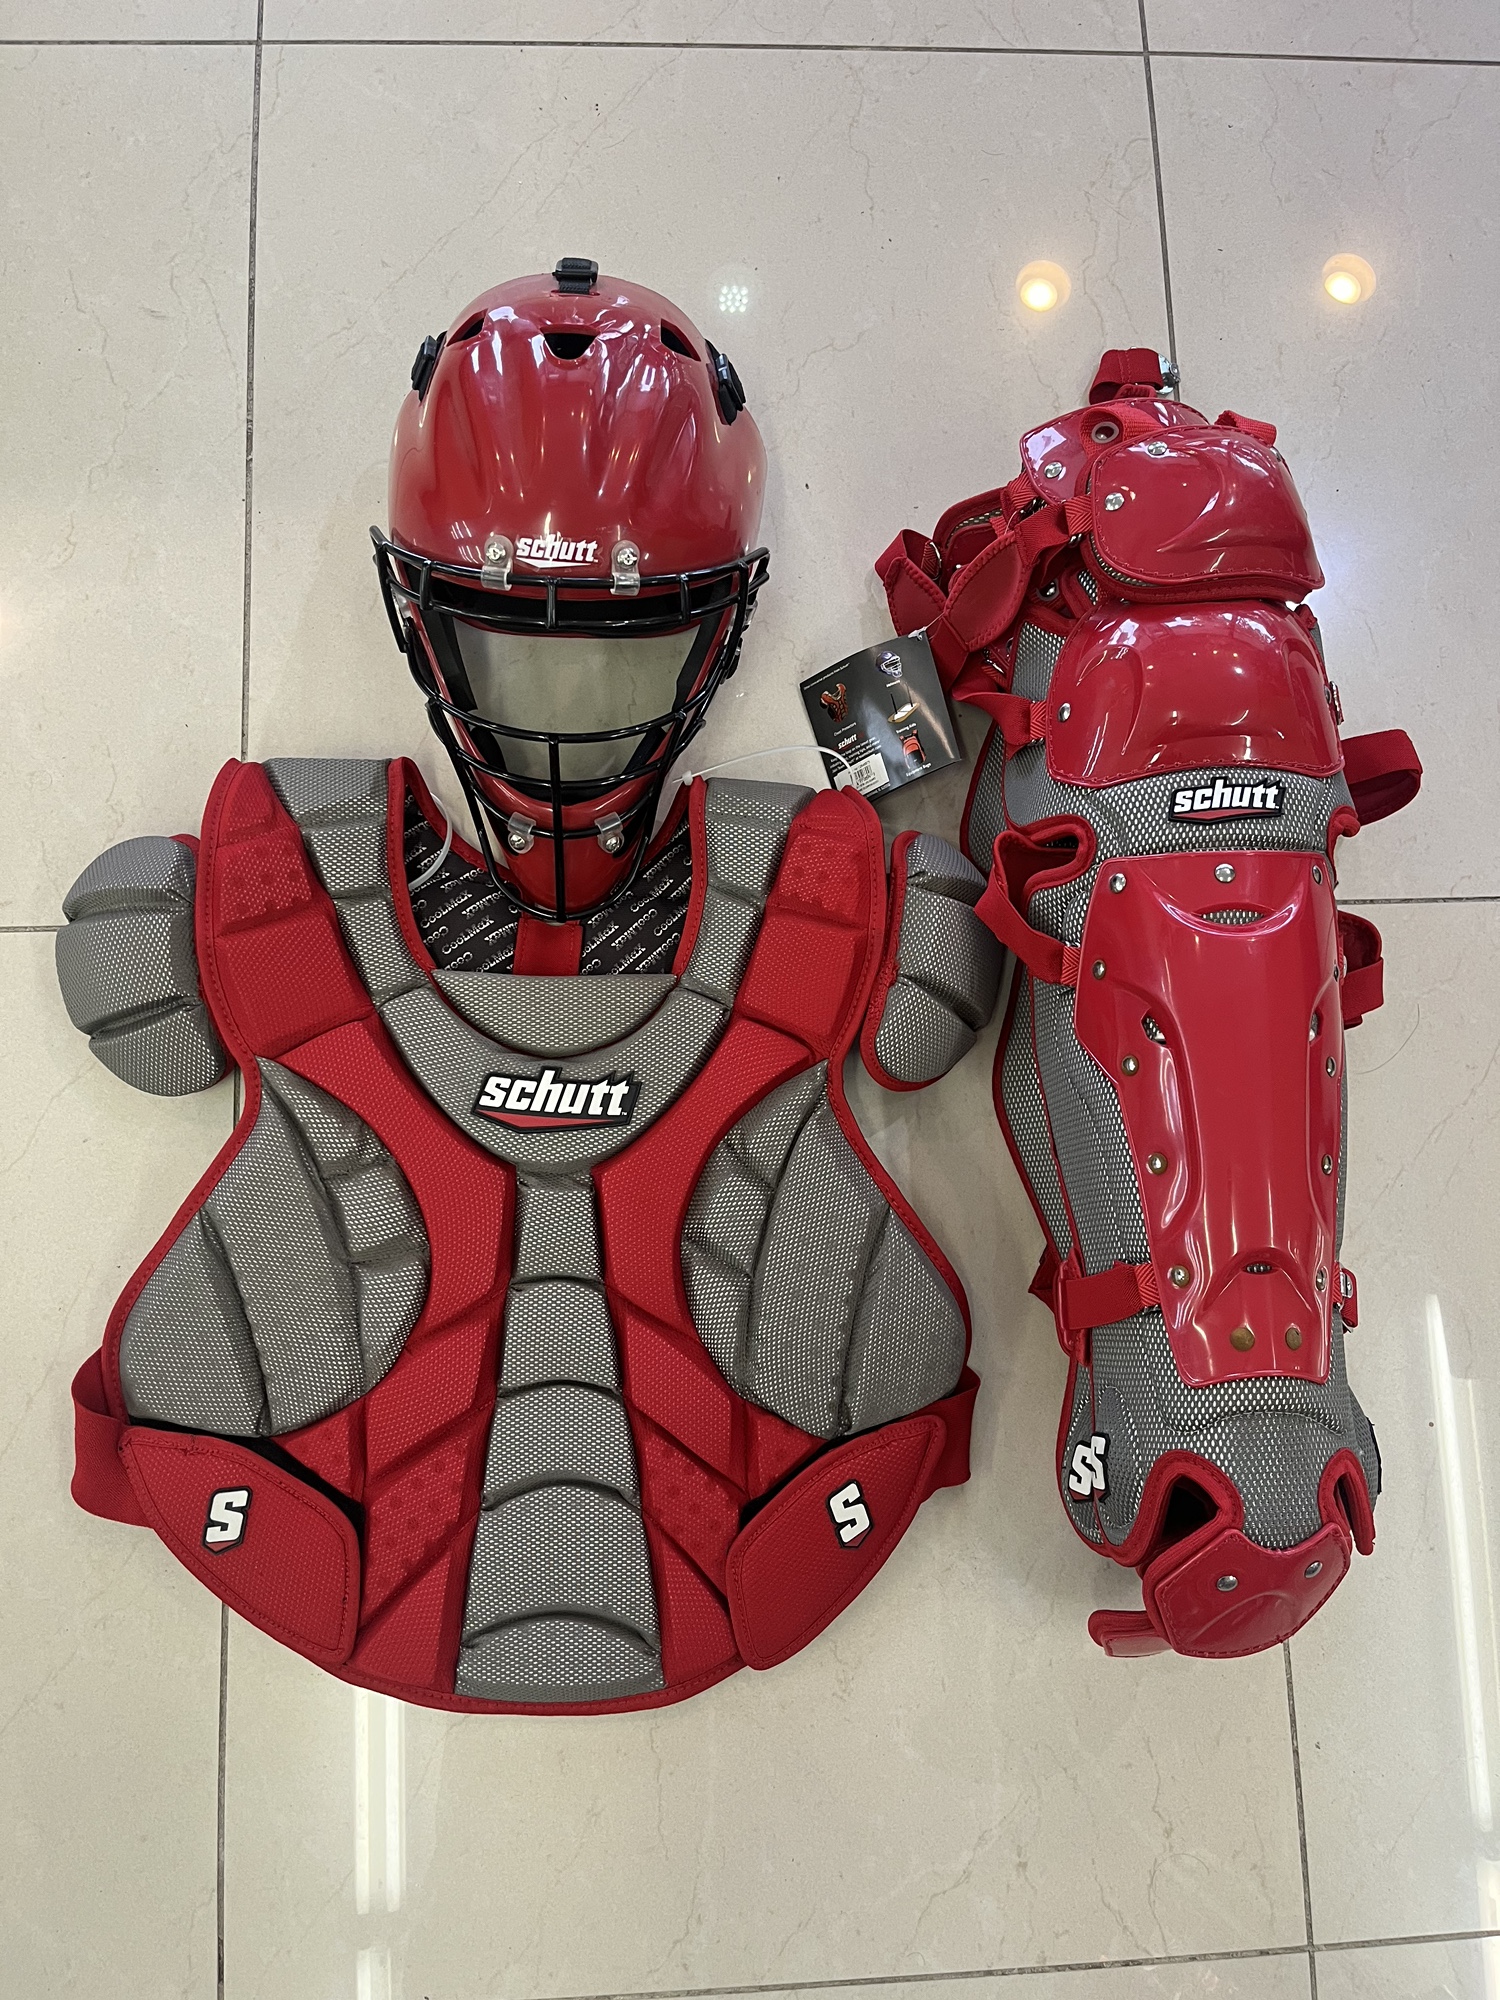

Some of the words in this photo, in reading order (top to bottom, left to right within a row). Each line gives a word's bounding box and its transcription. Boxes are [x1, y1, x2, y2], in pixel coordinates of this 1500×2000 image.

[516, 533, 598, 562] schutt
[1173, 779, 1279, 813] schutt
[478, 1069, 630, 1116] schutt
[205, 1490, 248, 1543] S
[829, 1483, 870, 1543] S
